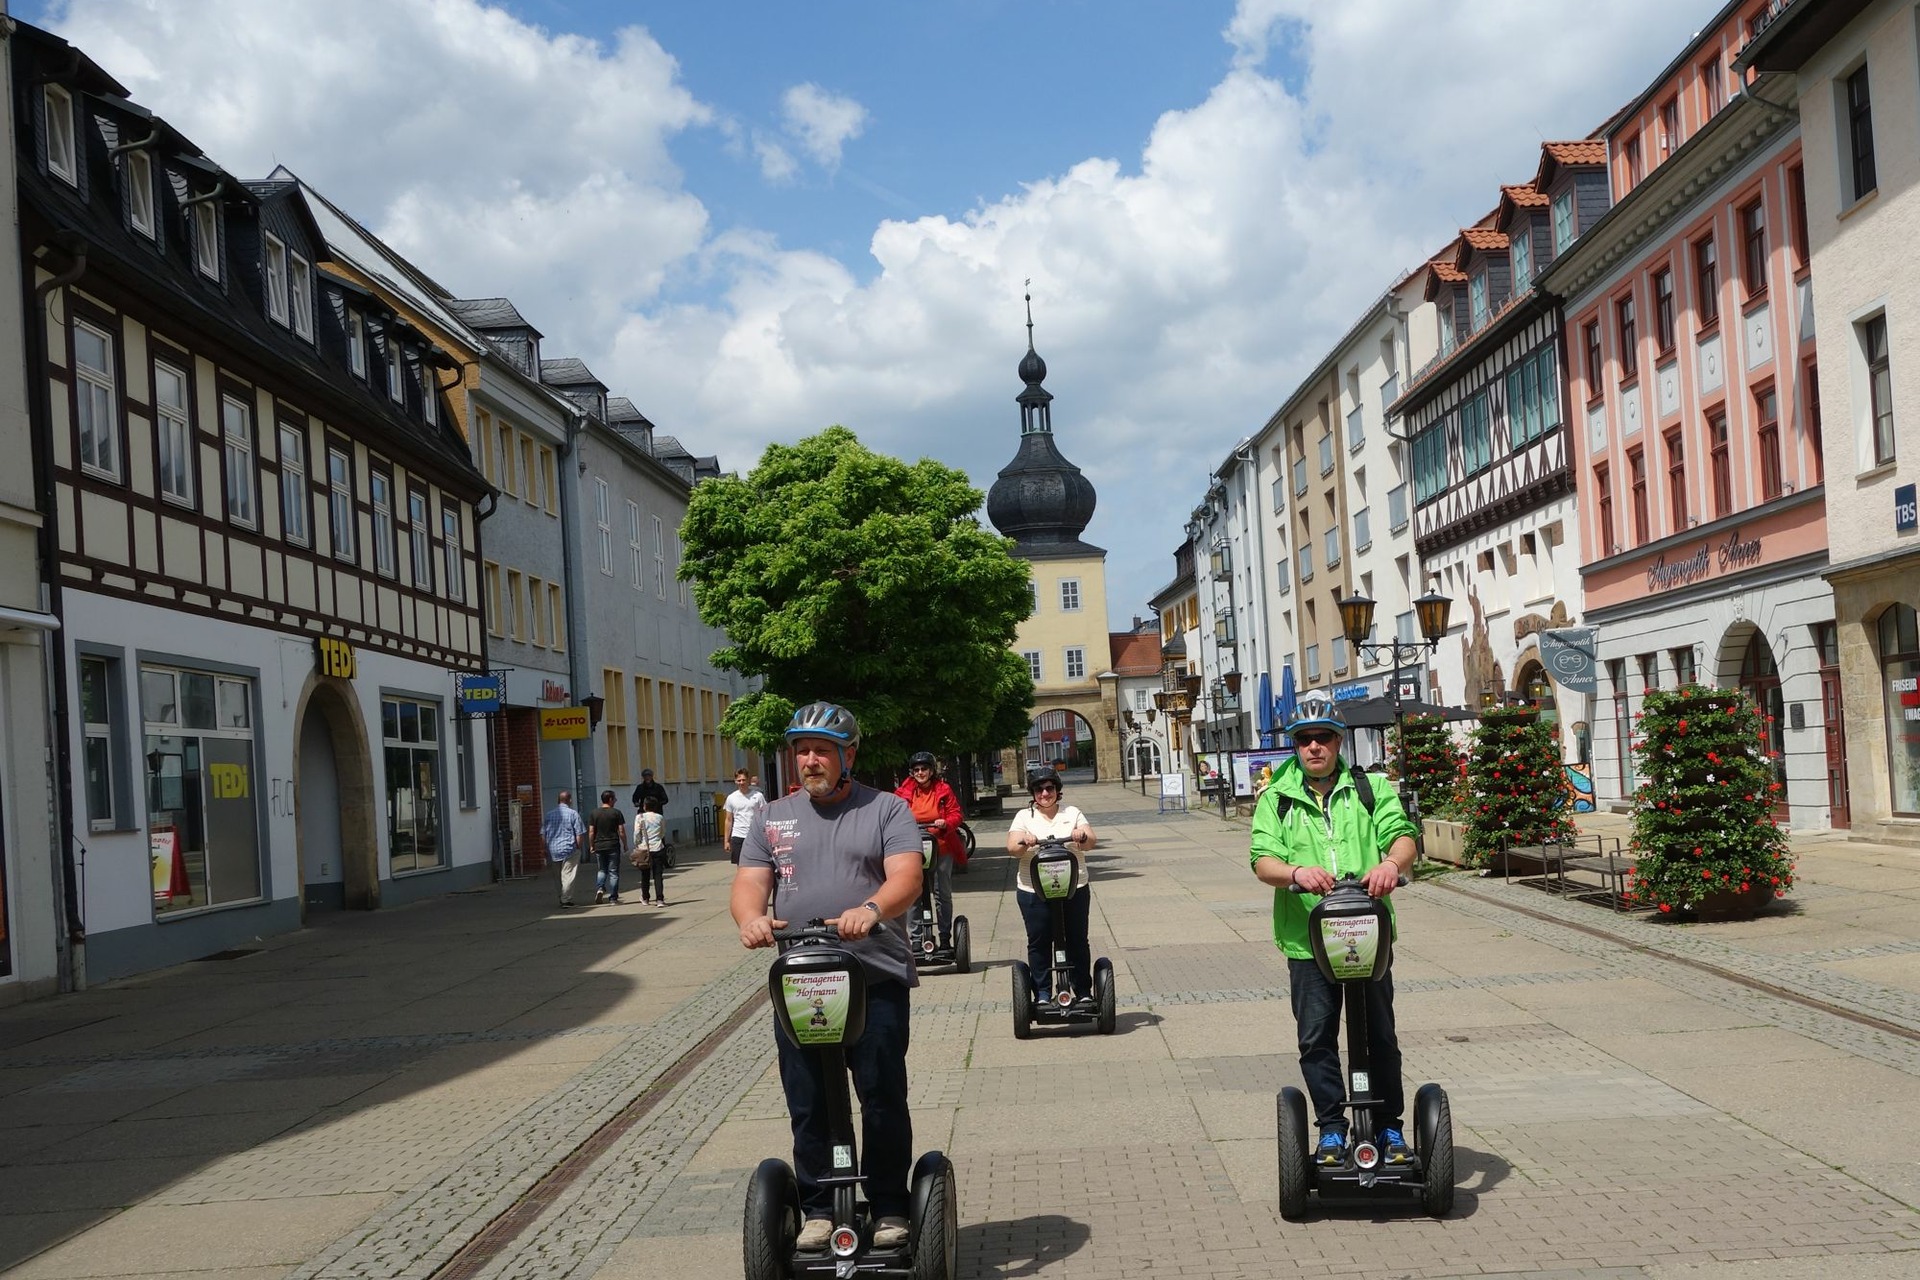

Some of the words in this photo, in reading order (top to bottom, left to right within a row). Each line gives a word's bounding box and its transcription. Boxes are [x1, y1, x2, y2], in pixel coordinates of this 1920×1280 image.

[1896, 502, 1916, 525] TBS
[320, 637, 357, 680] TEDi
[1892, 678, 1918, 692] FRISEUR
[464, 688, 497, 700] TEDi
[556, 716, 586, 726] LOTTO
[209, 763, 249, 799] TEDi
[1323, 918, 1375, 928] Ferienagentur
[1333, 929, 1368, 939] Hofmann
[785, 975, 846, 986] Ferienagentur
[796, 987, 837, 1000] Hofmann
[836, 1157, 849, 1166] CBA
